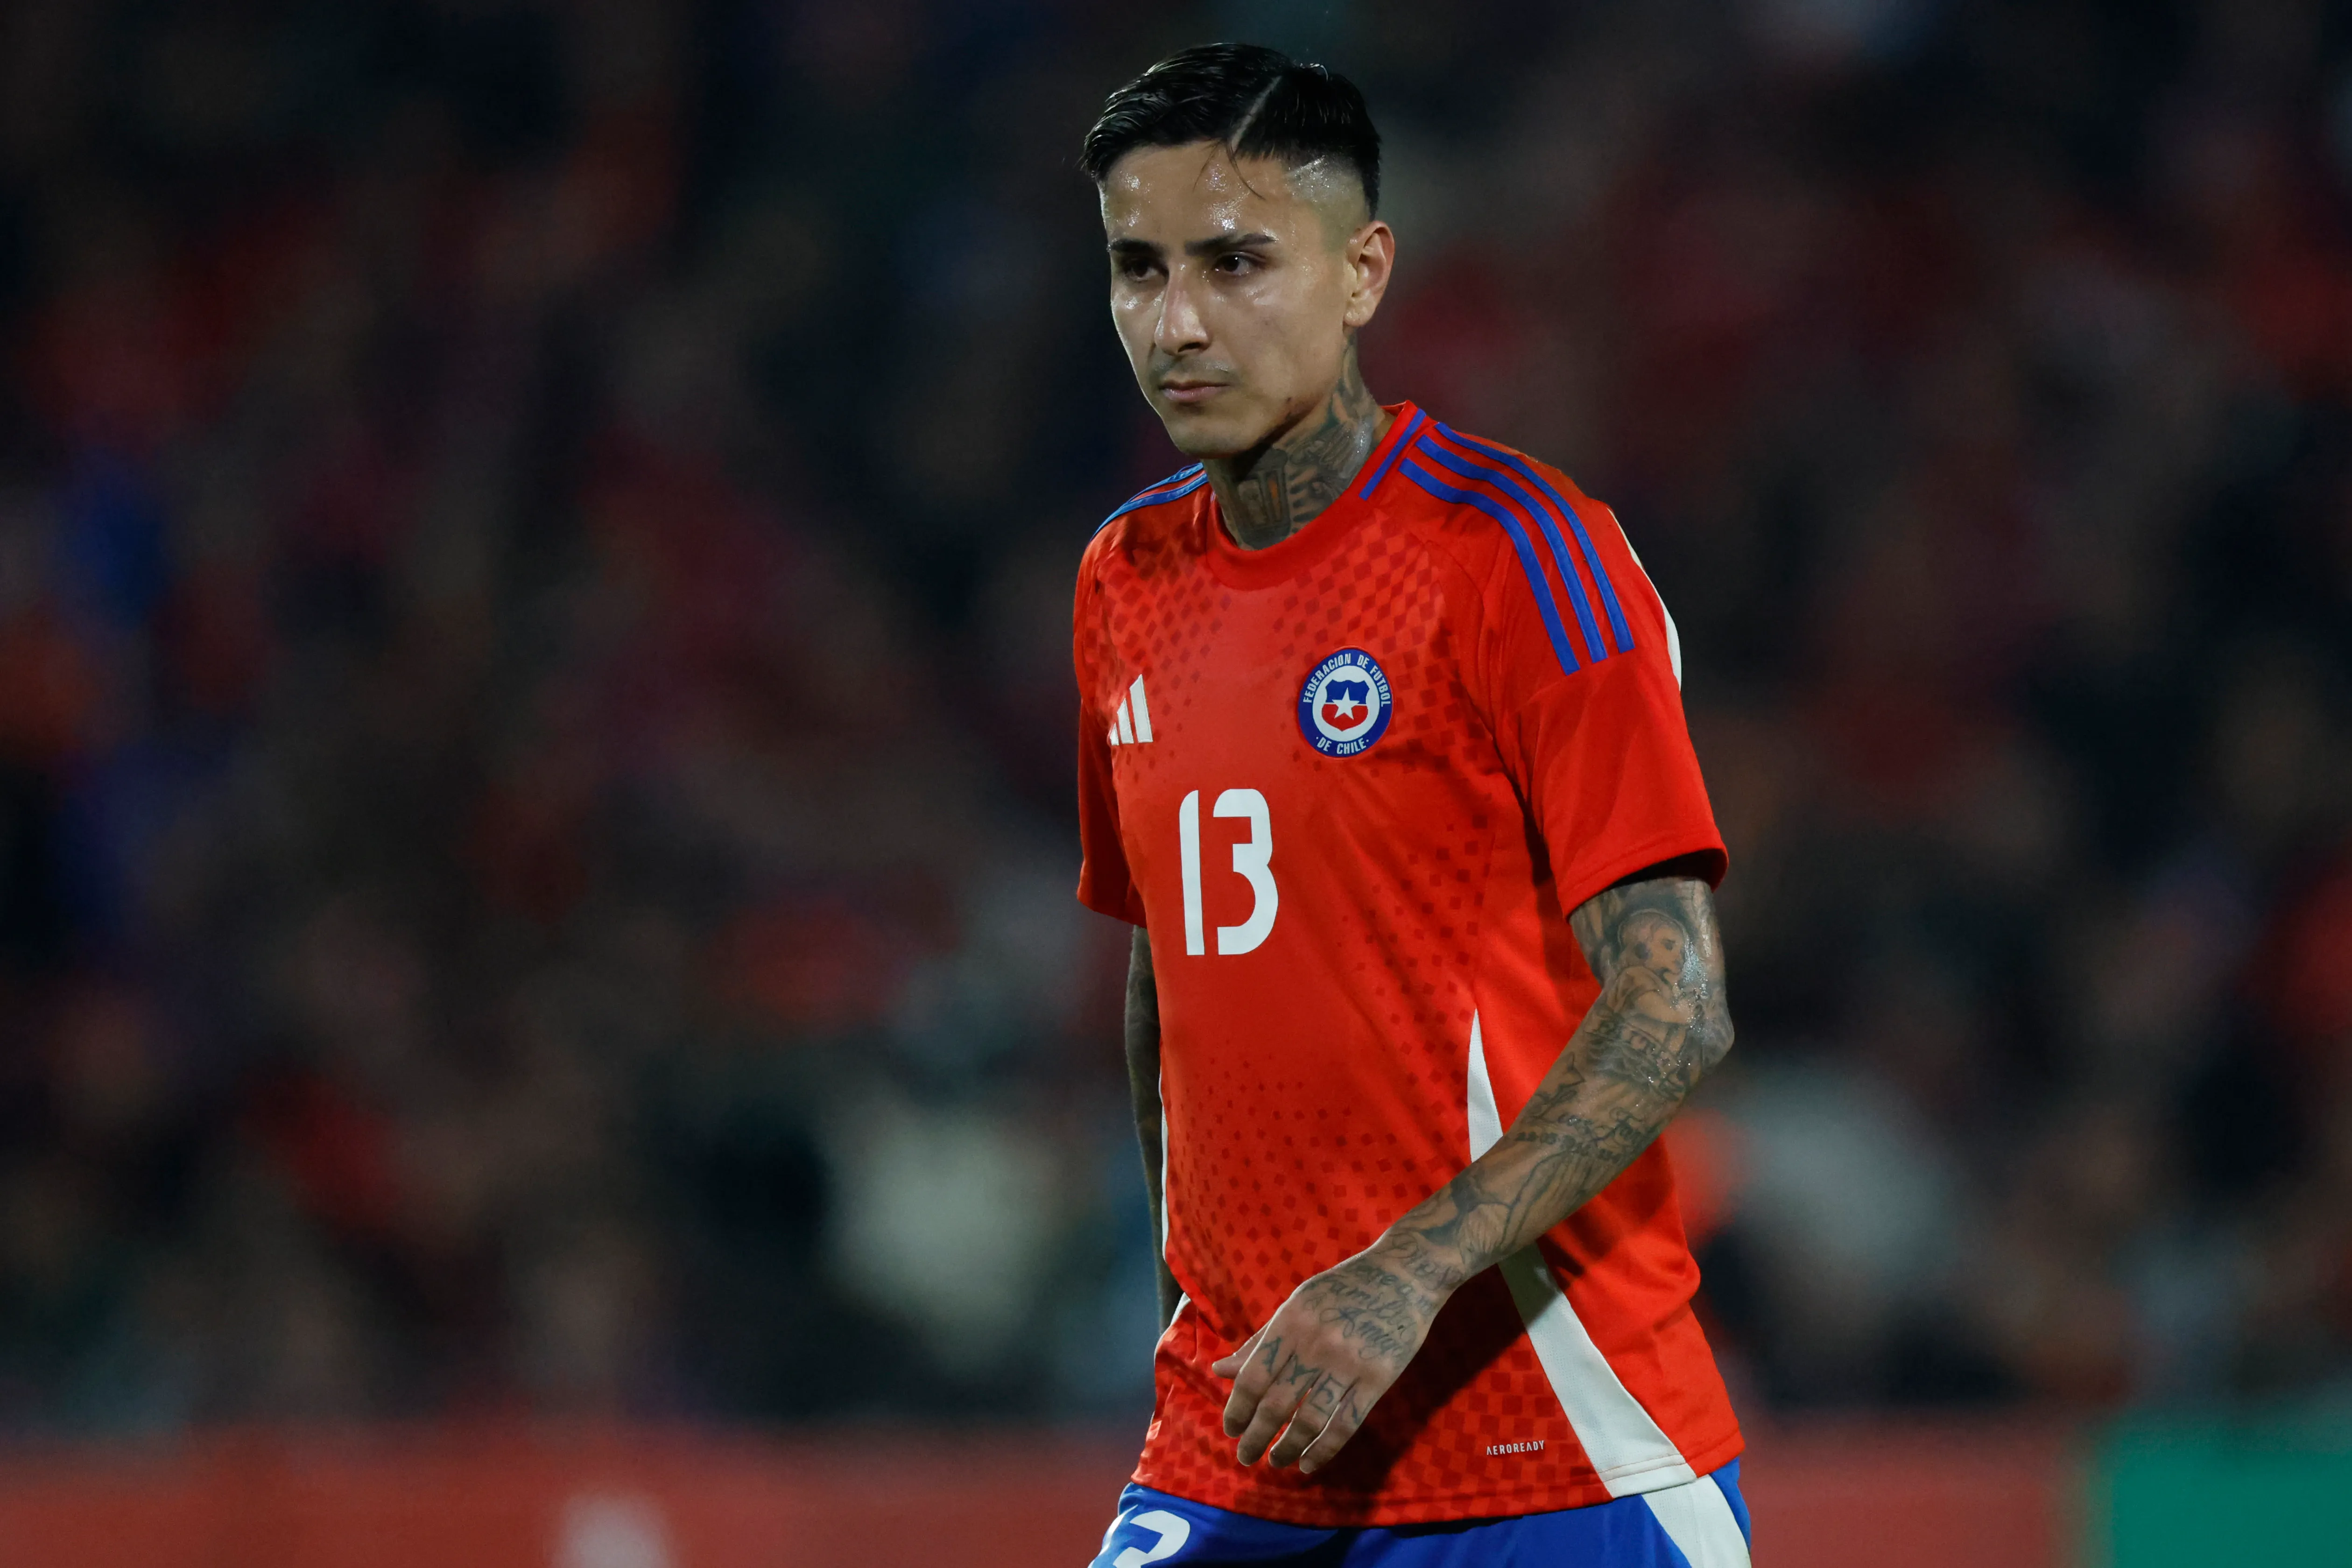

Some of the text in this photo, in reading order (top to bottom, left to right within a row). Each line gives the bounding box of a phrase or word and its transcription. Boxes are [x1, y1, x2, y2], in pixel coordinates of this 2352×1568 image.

[1303, 653, 1391, 708] FEDERACION DE FUTBOL
[1317, 737, 1366, 754] DE CHILE
[1179, 788, 1279, 956] 13
[1486, 1440, 1544, 1455] AEROREADY
